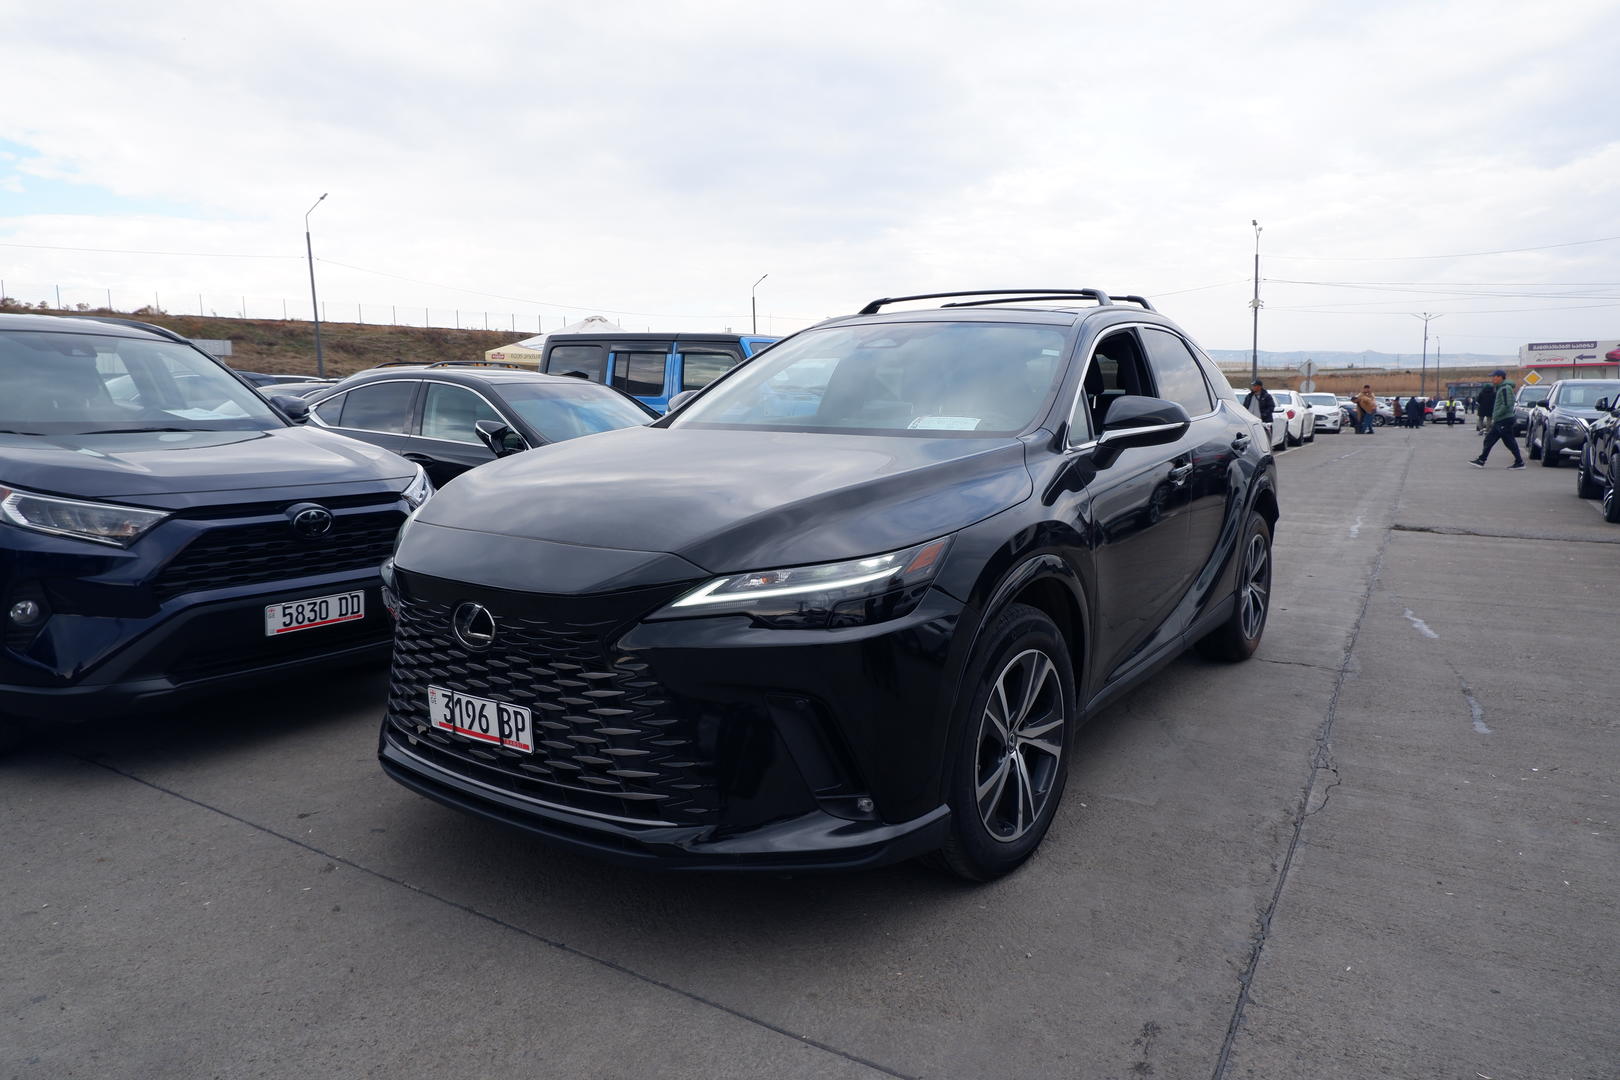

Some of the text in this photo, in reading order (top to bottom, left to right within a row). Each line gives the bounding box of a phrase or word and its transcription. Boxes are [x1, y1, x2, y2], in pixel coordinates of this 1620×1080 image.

[282, 594, 360, 627] 5830 DD
[442, 693, 526, 742] 3196 BP
